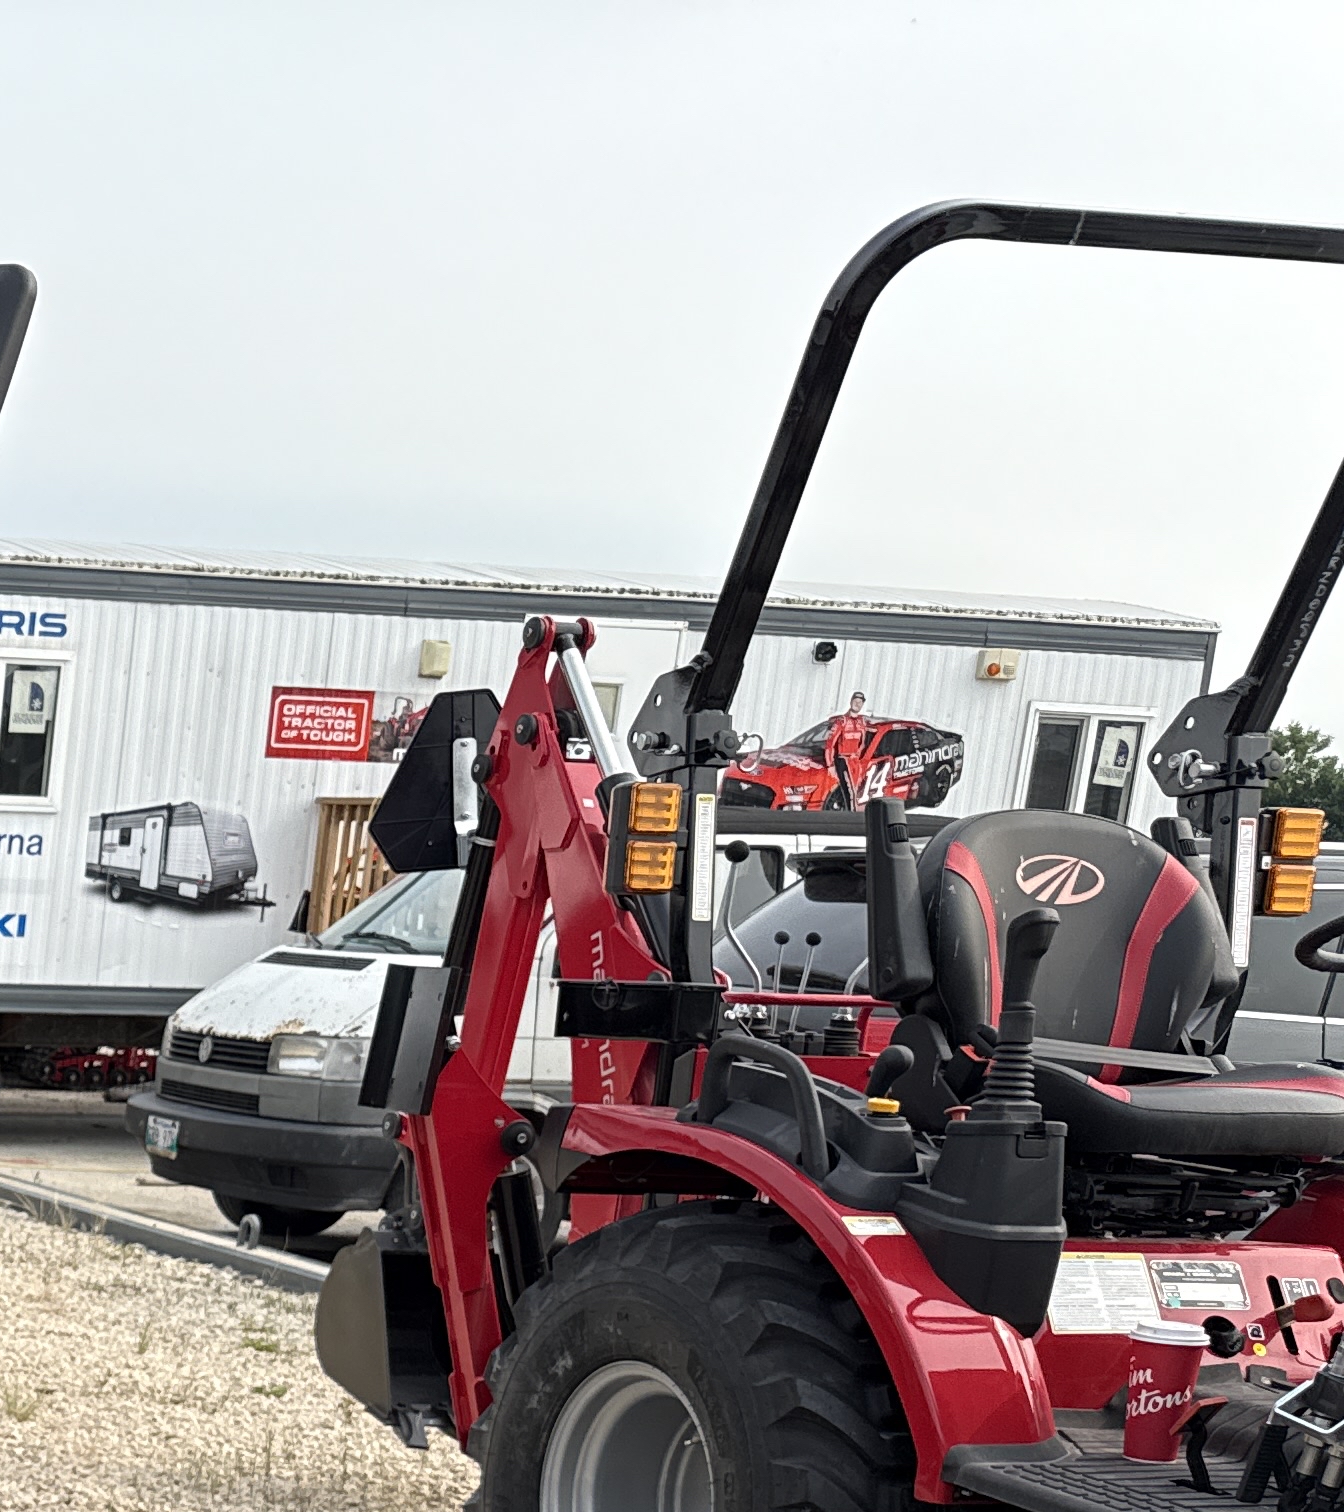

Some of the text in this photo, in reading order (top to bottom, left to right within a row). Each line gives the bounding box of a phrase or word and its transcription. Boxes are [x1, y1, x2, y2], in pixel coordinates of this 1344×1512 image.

[282, 704, 357, 718] OFFICIAL
[281, 717, 356, 730] TRACTOR
[280, 729, 299, 739] OF
[861, 762, 892, 802] 14
